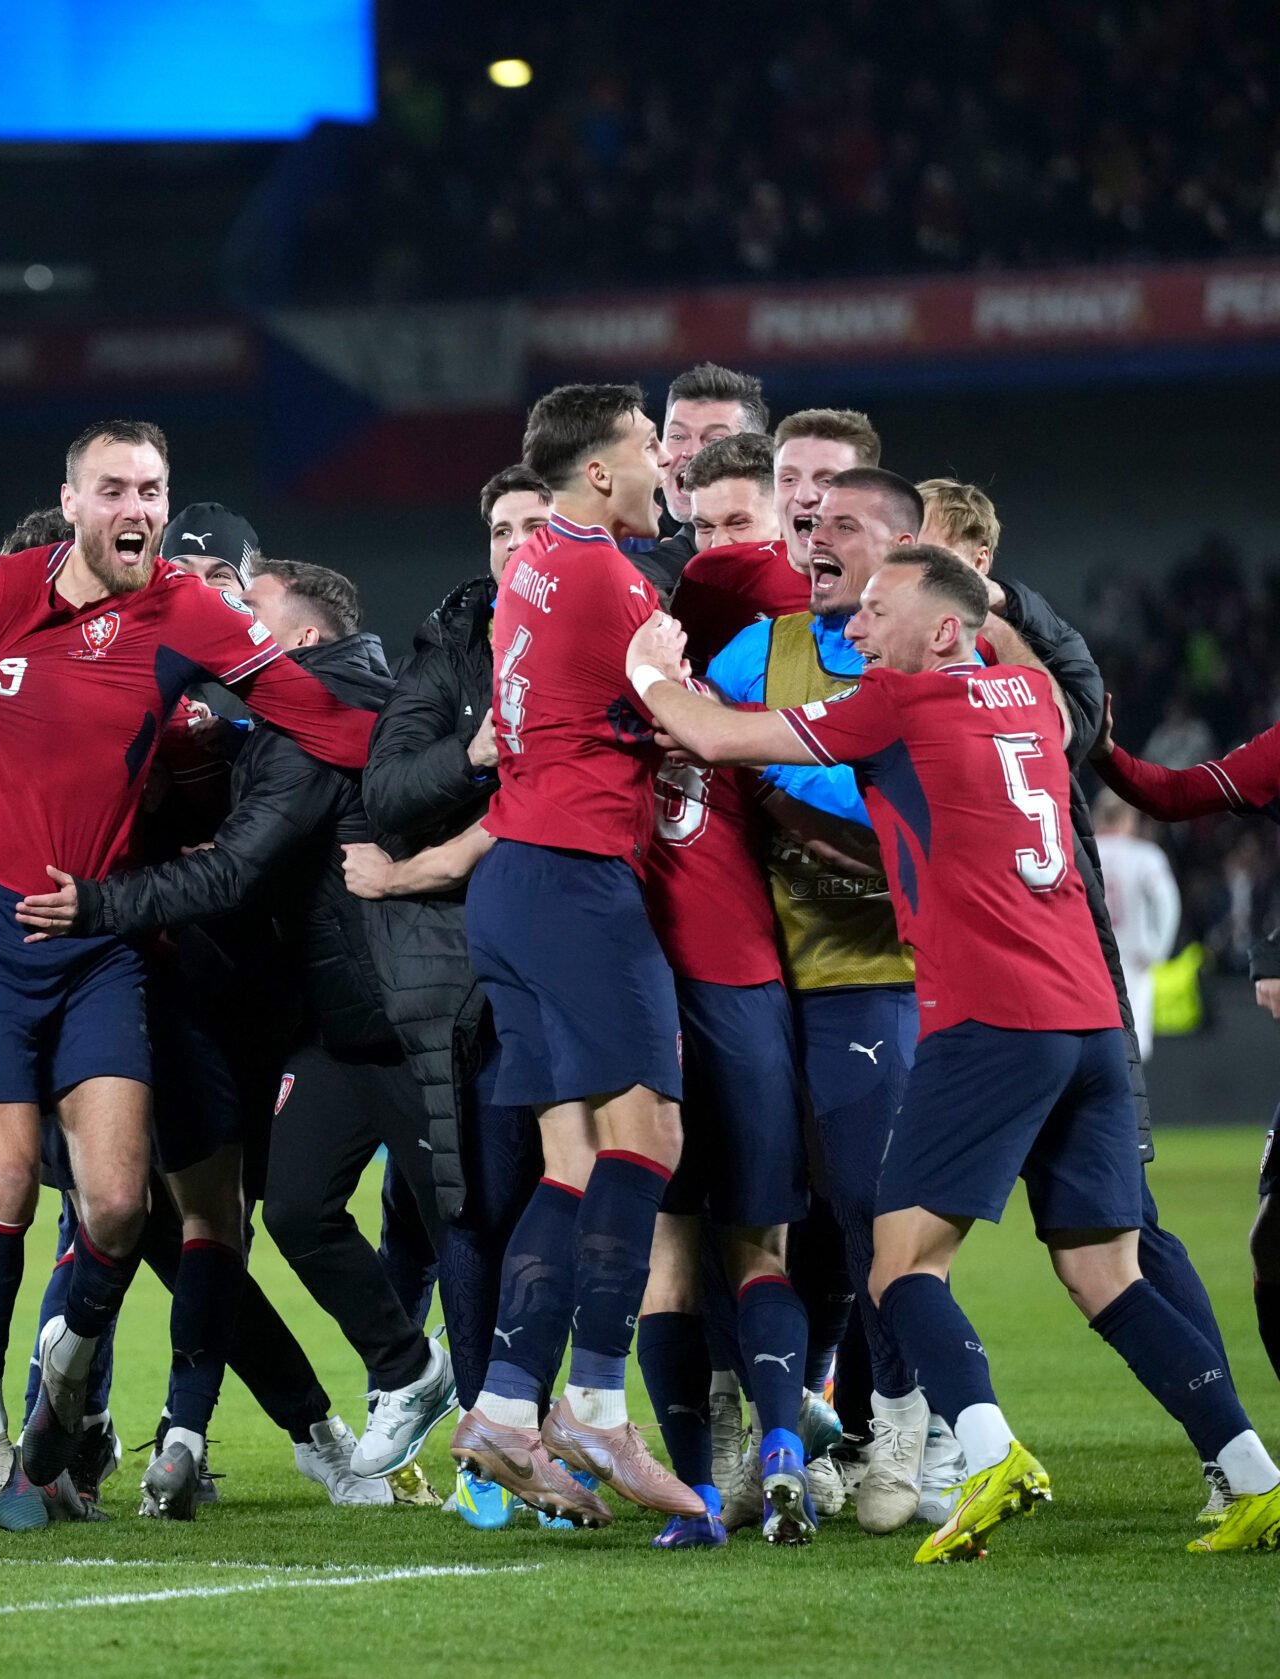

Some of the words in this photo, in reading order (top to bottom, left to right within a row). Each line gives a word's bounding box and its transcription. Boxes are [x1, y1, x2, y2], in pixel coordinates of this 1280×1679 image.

[746, 296, 914, 350] PENNY
[970, 279, 1146, 336] PENNY
[499, 624, 533, 754] 4
[967, 675, 1037, 709] COUFAL
[992, 731, 1068, 893] 5
[816, 875, 888, 897] RESPEC
[1187, 1368, 1224, 1391] CZE
